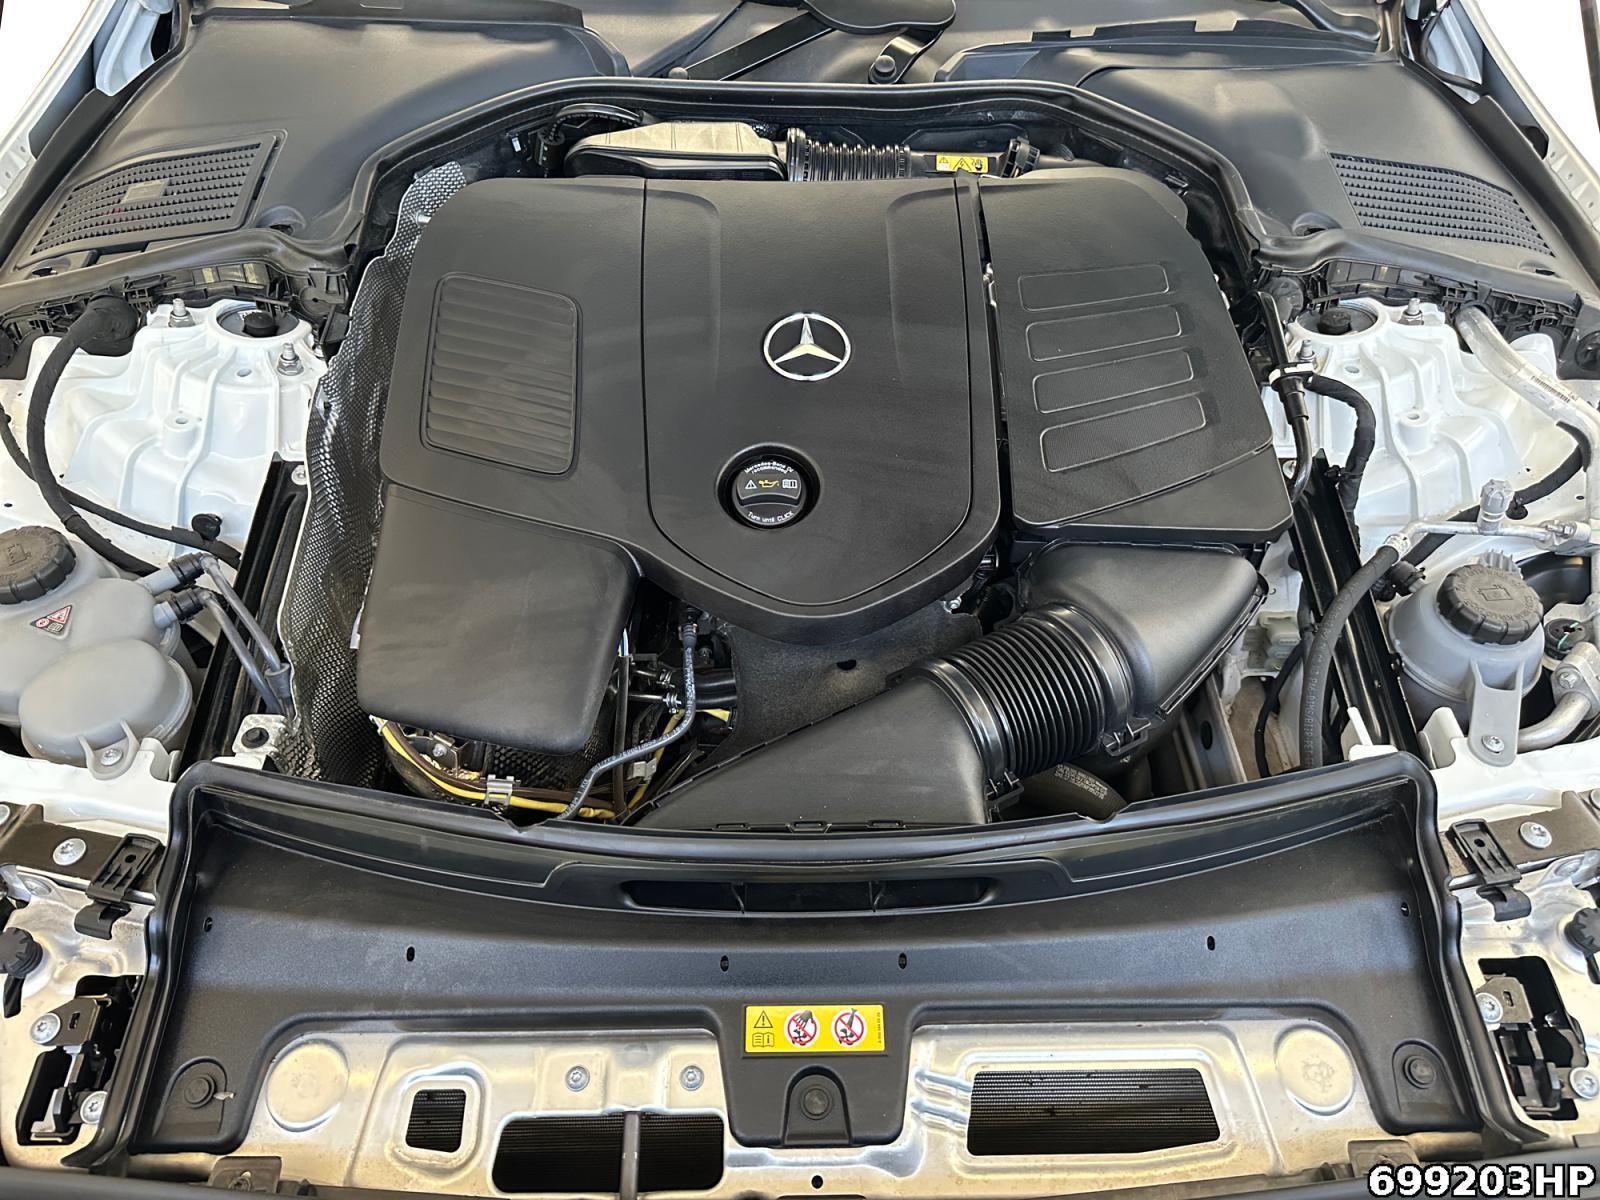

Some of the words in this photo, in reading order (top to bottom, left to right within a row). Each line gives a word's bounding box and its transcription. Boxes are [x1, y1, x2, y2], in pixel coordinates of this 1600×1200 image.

[744, 461, 786, 474] Mercedes-Benz
[747, 511, 761, 521] Turn
[777, 510, 794, 522] CLICK
